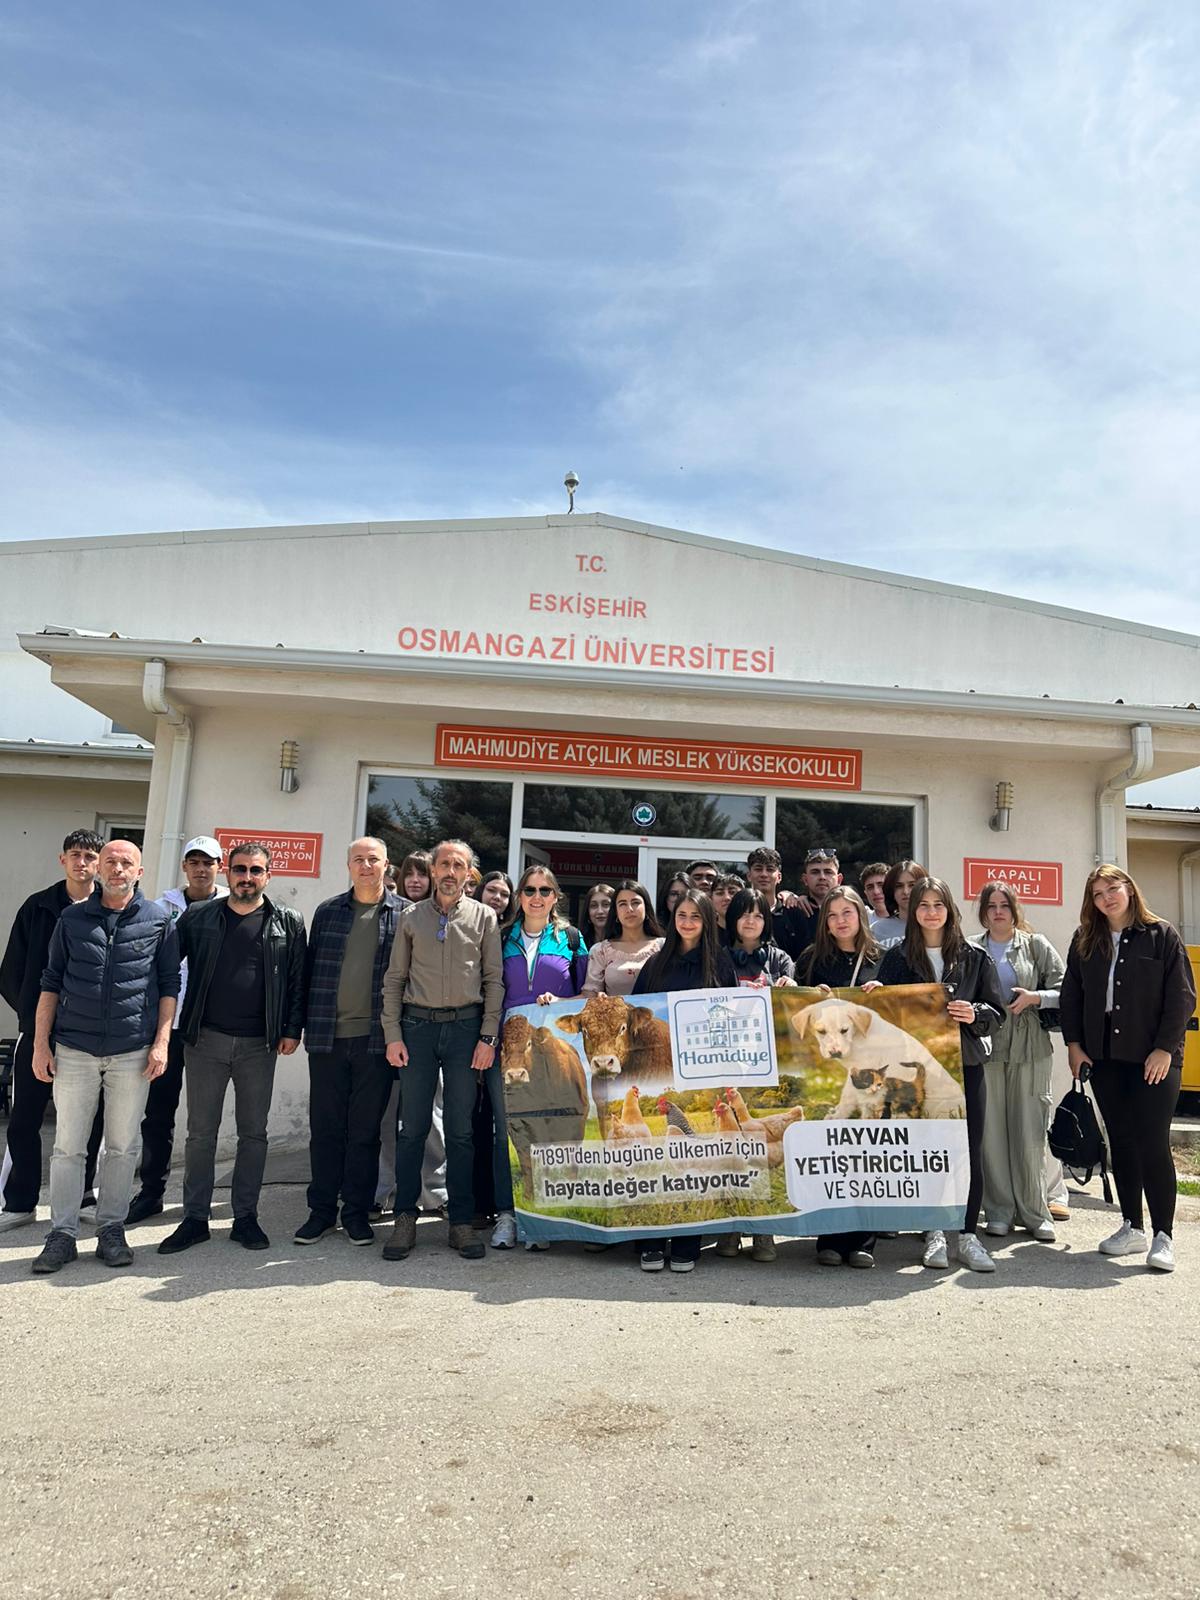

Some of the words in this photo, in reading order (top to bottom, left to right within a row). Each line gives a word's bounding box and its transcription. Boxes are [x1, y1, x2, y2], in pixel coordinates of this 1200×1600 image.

[575, 554, 607, 573] T.C.
[529, 592, 647, 619] ESKİŞEHİR
[398, 626, 575, 660] OSMANGAZİ
[584, 635, 775, 673] ÜNİVERSİTESİ
[449, 736, 559, 761] MAHMUDİYE
[563, 743, 632, 767] ATÇILIK
[637, 748, 711, 769] MESLEK
[715, 750, 850, 778] YÜKSEKOKULU
[293, 842, 306, 850] VE
[987, 868, 1042, 881] KAPALI
[709, 995, 729, 1003] 1891
[680, 1049, 769, 1066] Hamidiye
[826, 1127, 909, 1146] HAYVAN
[603, 1145, 664, 1166] bugüne
[669, 1138, 733, 1160] ülkemiz
[736, 1138, 766, 1160] için
[795, 1149, 950, 1177] YETİŞTİRİCİLİĞİ
[545, 1180, 600, 1200] hayata
[603, 1177, 658, 1199] değer
[824, 1181, 846, 1200] VE
[850, 1176, 920, 1199] SAĞLIĞI
